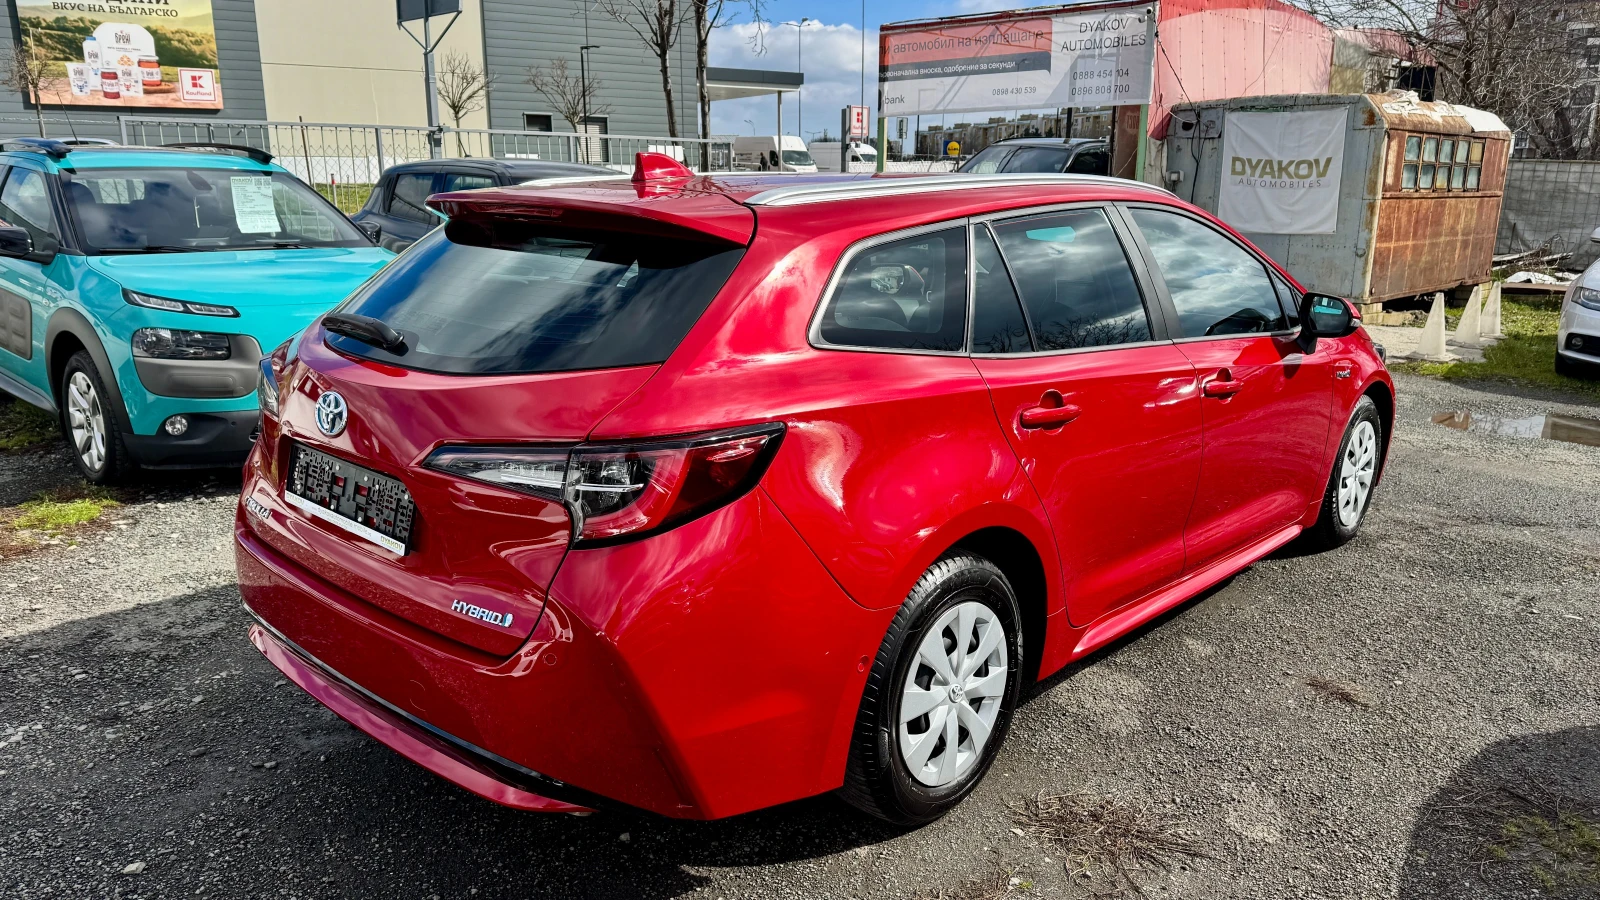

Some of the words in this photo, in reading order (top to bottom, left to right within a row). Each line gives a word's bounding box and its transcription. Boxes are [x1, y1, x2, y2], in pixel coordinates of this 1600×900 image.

[52, 2, 85, 12] ВКУС
[88, 4, 106, 13] НА
[109, 5, 179, 17] БЪЛГАРСКО
[1079, 18, 1129, 34] DYAKOV
[893, 37, 955, 54] автомобил
[957, 37, 972, 47] на
[975, 30, 1044, 45] изплащане
[1061, 34, 1146, 52] AUTOMOBILES
[920, 67, 943, 76] вноска,
[943, 64, 979, 73] одобрение
[988, 61, 1016, 70] секунди
[1072, 70, 1095, 80] 0888
[1096, 69, 1113, 79] 454
[1115, 68, 1130, 78] 104
[992, 88, 1009, 96] 0898
[1010, 87, 1023, 95] 430
[1024, 86, 1037, 94] 539
[1071, 86, 1093, 96] 0896
[1095, 85, 1112, 95] 808
[1114, 84, 1130, 93] 700
[884, 94, 905, 105] bank
[1230, 156, 1333, 180] DYAKOV
[1238, 177, 1322, 189] AUTOMOBILES
[451, 599, 503, 626] HYBRID
